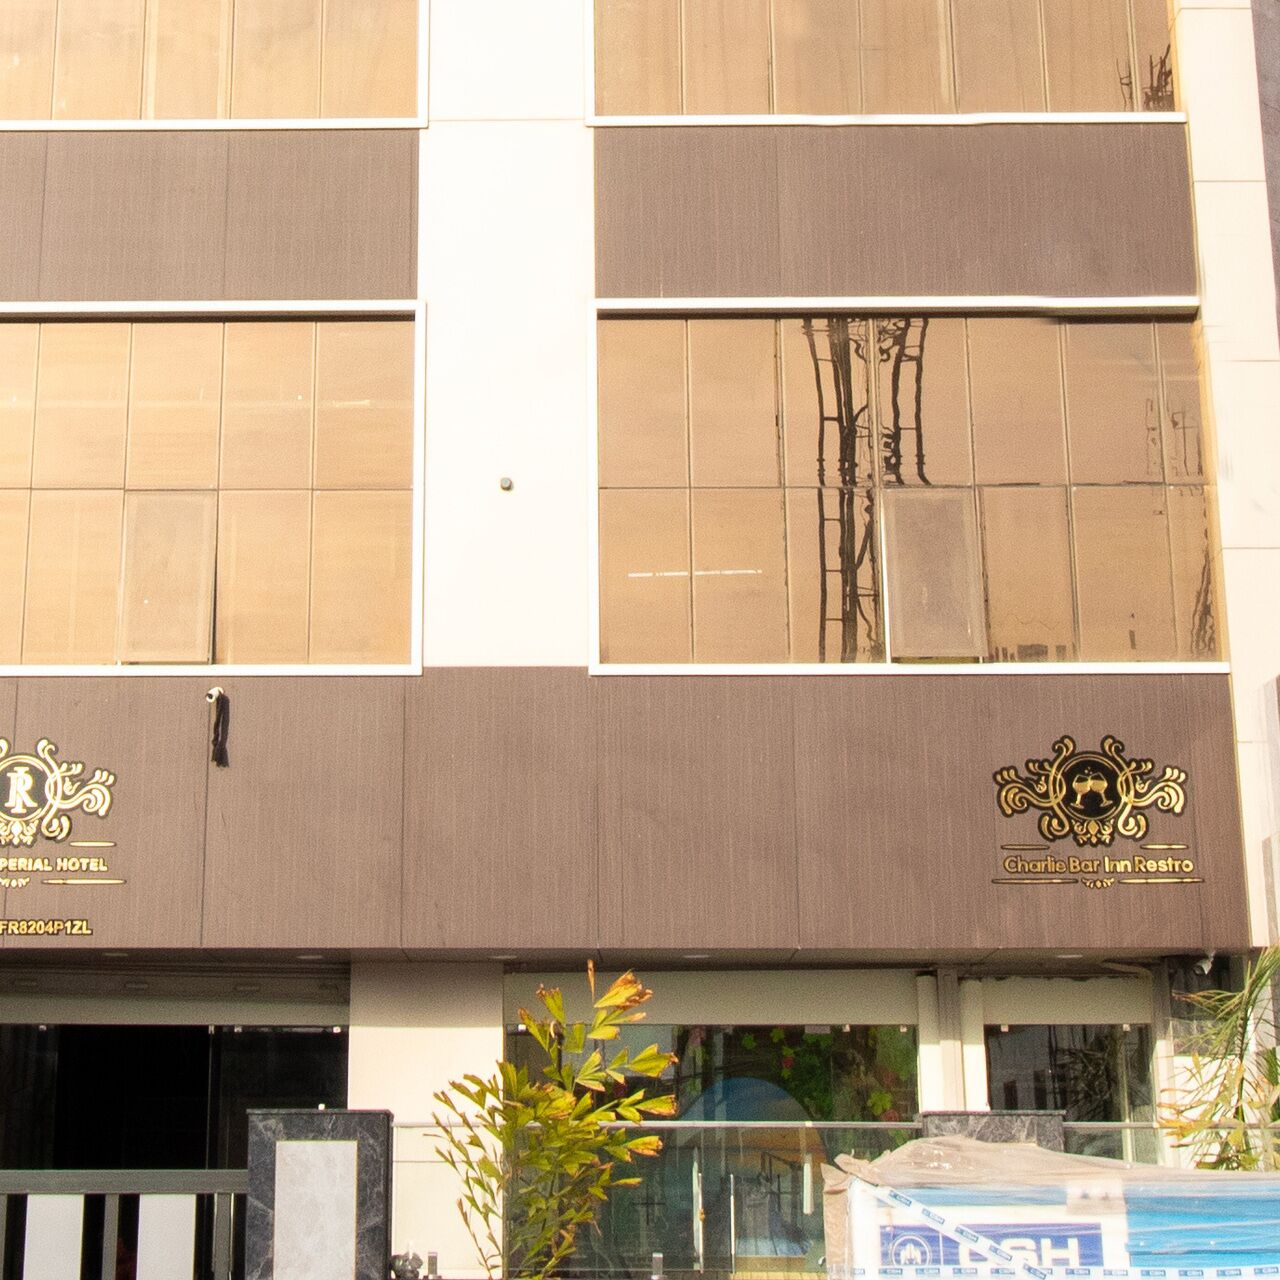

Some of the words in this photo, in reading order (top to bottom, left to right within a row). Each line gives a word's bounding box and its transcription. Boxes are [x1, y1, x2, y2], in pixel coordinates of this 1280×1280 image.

[56, 857, 108, 871] HOTEL
[1004, 855, 1066, 874] Charlie
[1069, 856, 1100, 873] Bar
[1104, 856, 1131, 873] Inn
[1135, 856, 1194, 873] Restro
